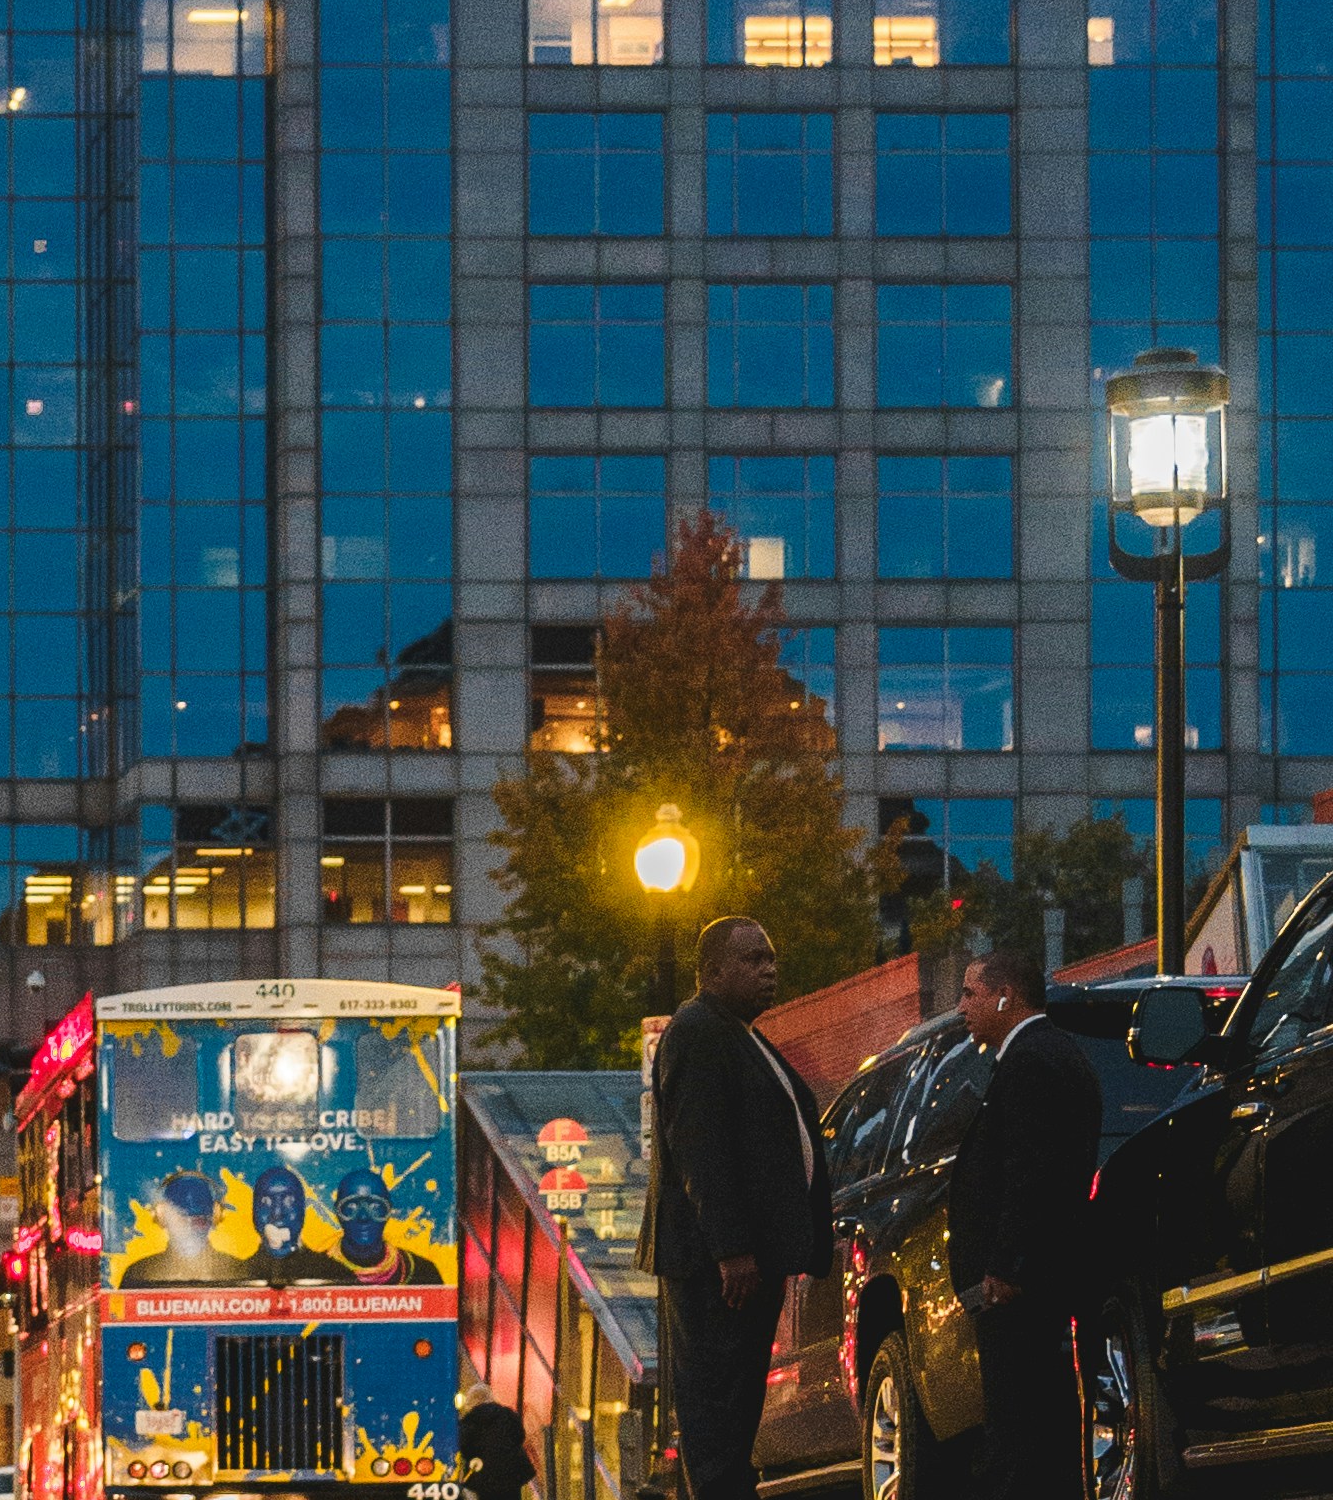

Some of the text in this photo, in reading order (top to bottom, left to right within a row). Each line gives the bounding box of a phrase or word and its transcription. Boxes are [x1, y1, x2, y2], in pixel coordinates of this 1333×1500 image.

[122, 1001, 232, 1013] TROLLEYTOURS.COM
[171, 1110, 235, 1131] HARD
[555, 1121, 572, 1142] F
[199, 1133, 256, 1153] EASY
[546, 1145, 582, 1161] B5A
[555, 1170, 572, 1191] F
[546, 1193, 582, 1210] B5B
[136, 1295, 423, 1315] BLUEMAN.COM 1.800.BLUEMAN
